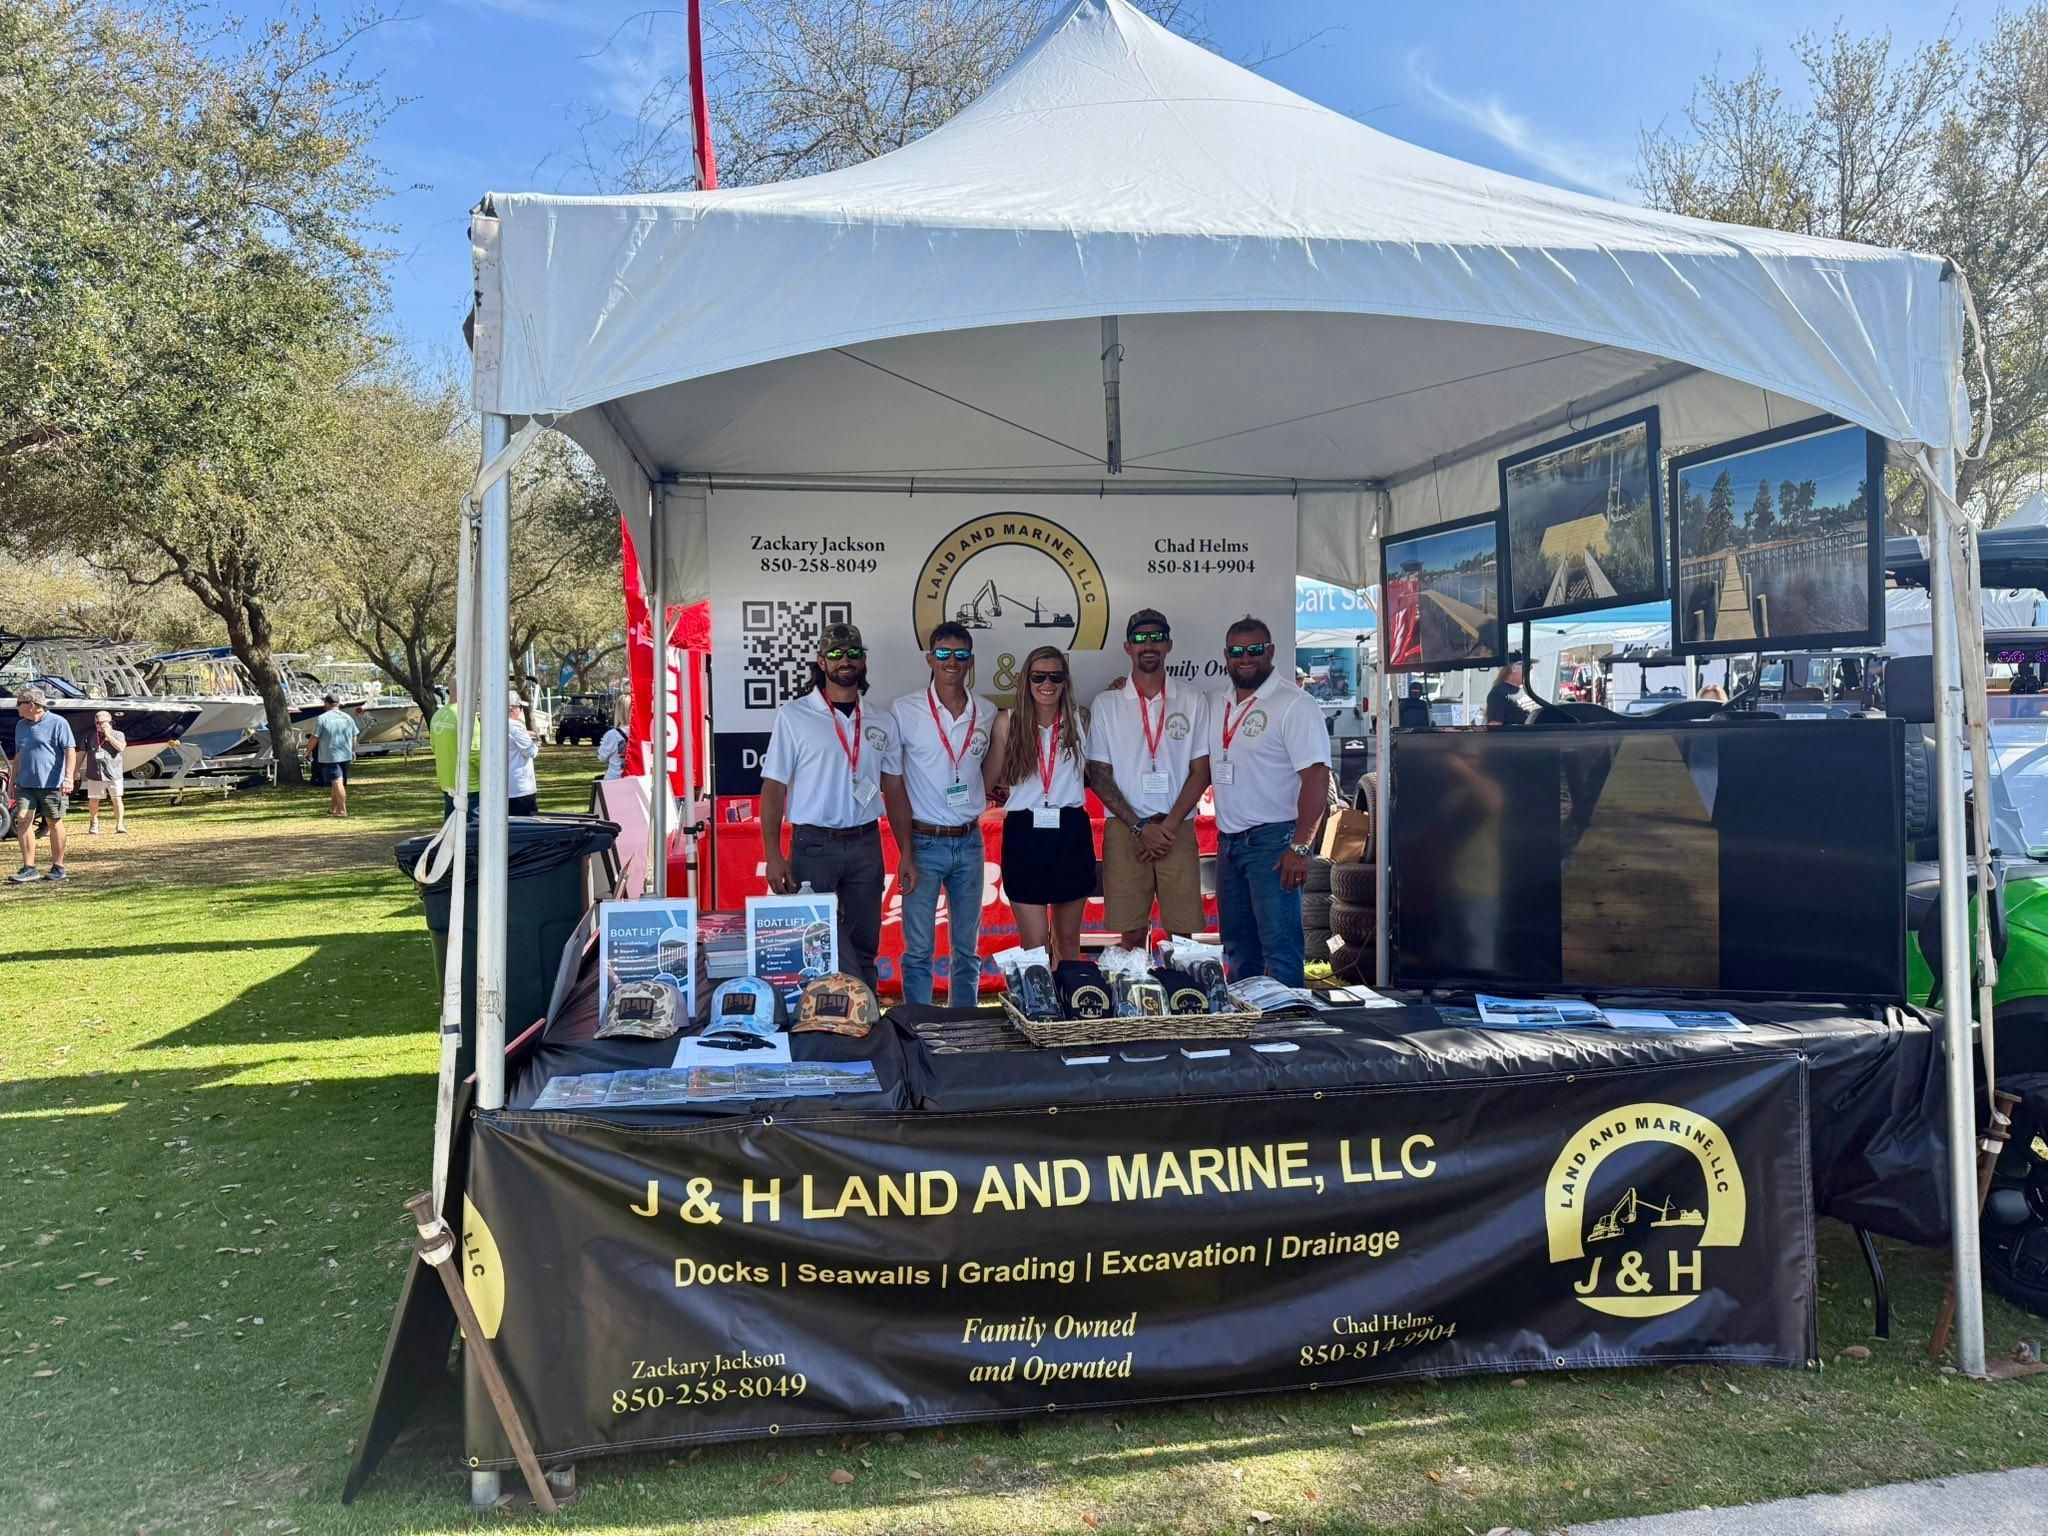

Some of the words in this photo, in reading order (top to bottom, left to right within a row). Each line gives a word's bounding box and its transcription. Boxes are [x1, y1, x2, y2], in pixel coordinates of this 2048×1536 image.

[750, 536, 819, 556] Zackary
[823, 536, 886, 553] Jackson
[1154, 538, 1195, 554] Chad
[1198, 538, 1249, 554] Helms
[760, 557, 878, 574] 850-258-8049
[927, 551, 957, 600] LAND
[960, 527, 996, 552] AND
[1003, 524, 1075, 567] MARINE,
[1076, 569, 1097, 603] LLC
[1147, 558, 1256, 574] 850-814-9904
[1166, 660, 1200, 682] mily
[610, 928, 638, 938] BOAT
[640, 927, 662, 937] LIFT
[757, 918, 784, 928] BOAT
[785, 917, 806, 927] LIFT
[630, 1180, 659, 1218] J
[679, 1177, 722, 1226] &
[742, 1178, 780, 1223] H
[802, 1169, 958, 1220] LAND
[972, 1158, 1091, 1214] AND
[1107, 1140, 1325, 1202] MARINE,
[1340, 1133, 1438, 1184] LLC
[1560, 1152, 1588, 1209] LAND
[1589, 1121, 1628, 1150] AND
[1709, 1157, 1729, 1193] LLC
[463, 1231, 486, 1279] LLC
[674, 1257, 770, 1289] Docks
[797, 1263, 931, 1285] Seawalls
[958, 1256, 1076, 1286] Grading
[1102, 1243, 1256, 1276] Excavation
[1281, 1229, 1400, 1261] Drainage
[1574, 1257, 1604, 1295] J
[1616, 1250, 1652, 1293] &
[1669, 1250, 1702, 1291] H
[962, 1315, 1048, 1346] Family
[1054, 1311, 1136, 1341] Owned
[1332, 1314, 1379, 1336] Chad
[1382, 1312, 1435, 1331] Helms
[1299, 1322, 1457, 1368] 850-814-9904
[631, 1357, 712, 1381] Zackary
[713, 1349, 787, 1373] Jackson
[968, 1358, 1018, 1383] and
[1022, 1352, 1133, 1386] Operated
[611, 1372, 808, 1415] 850-258-8049
